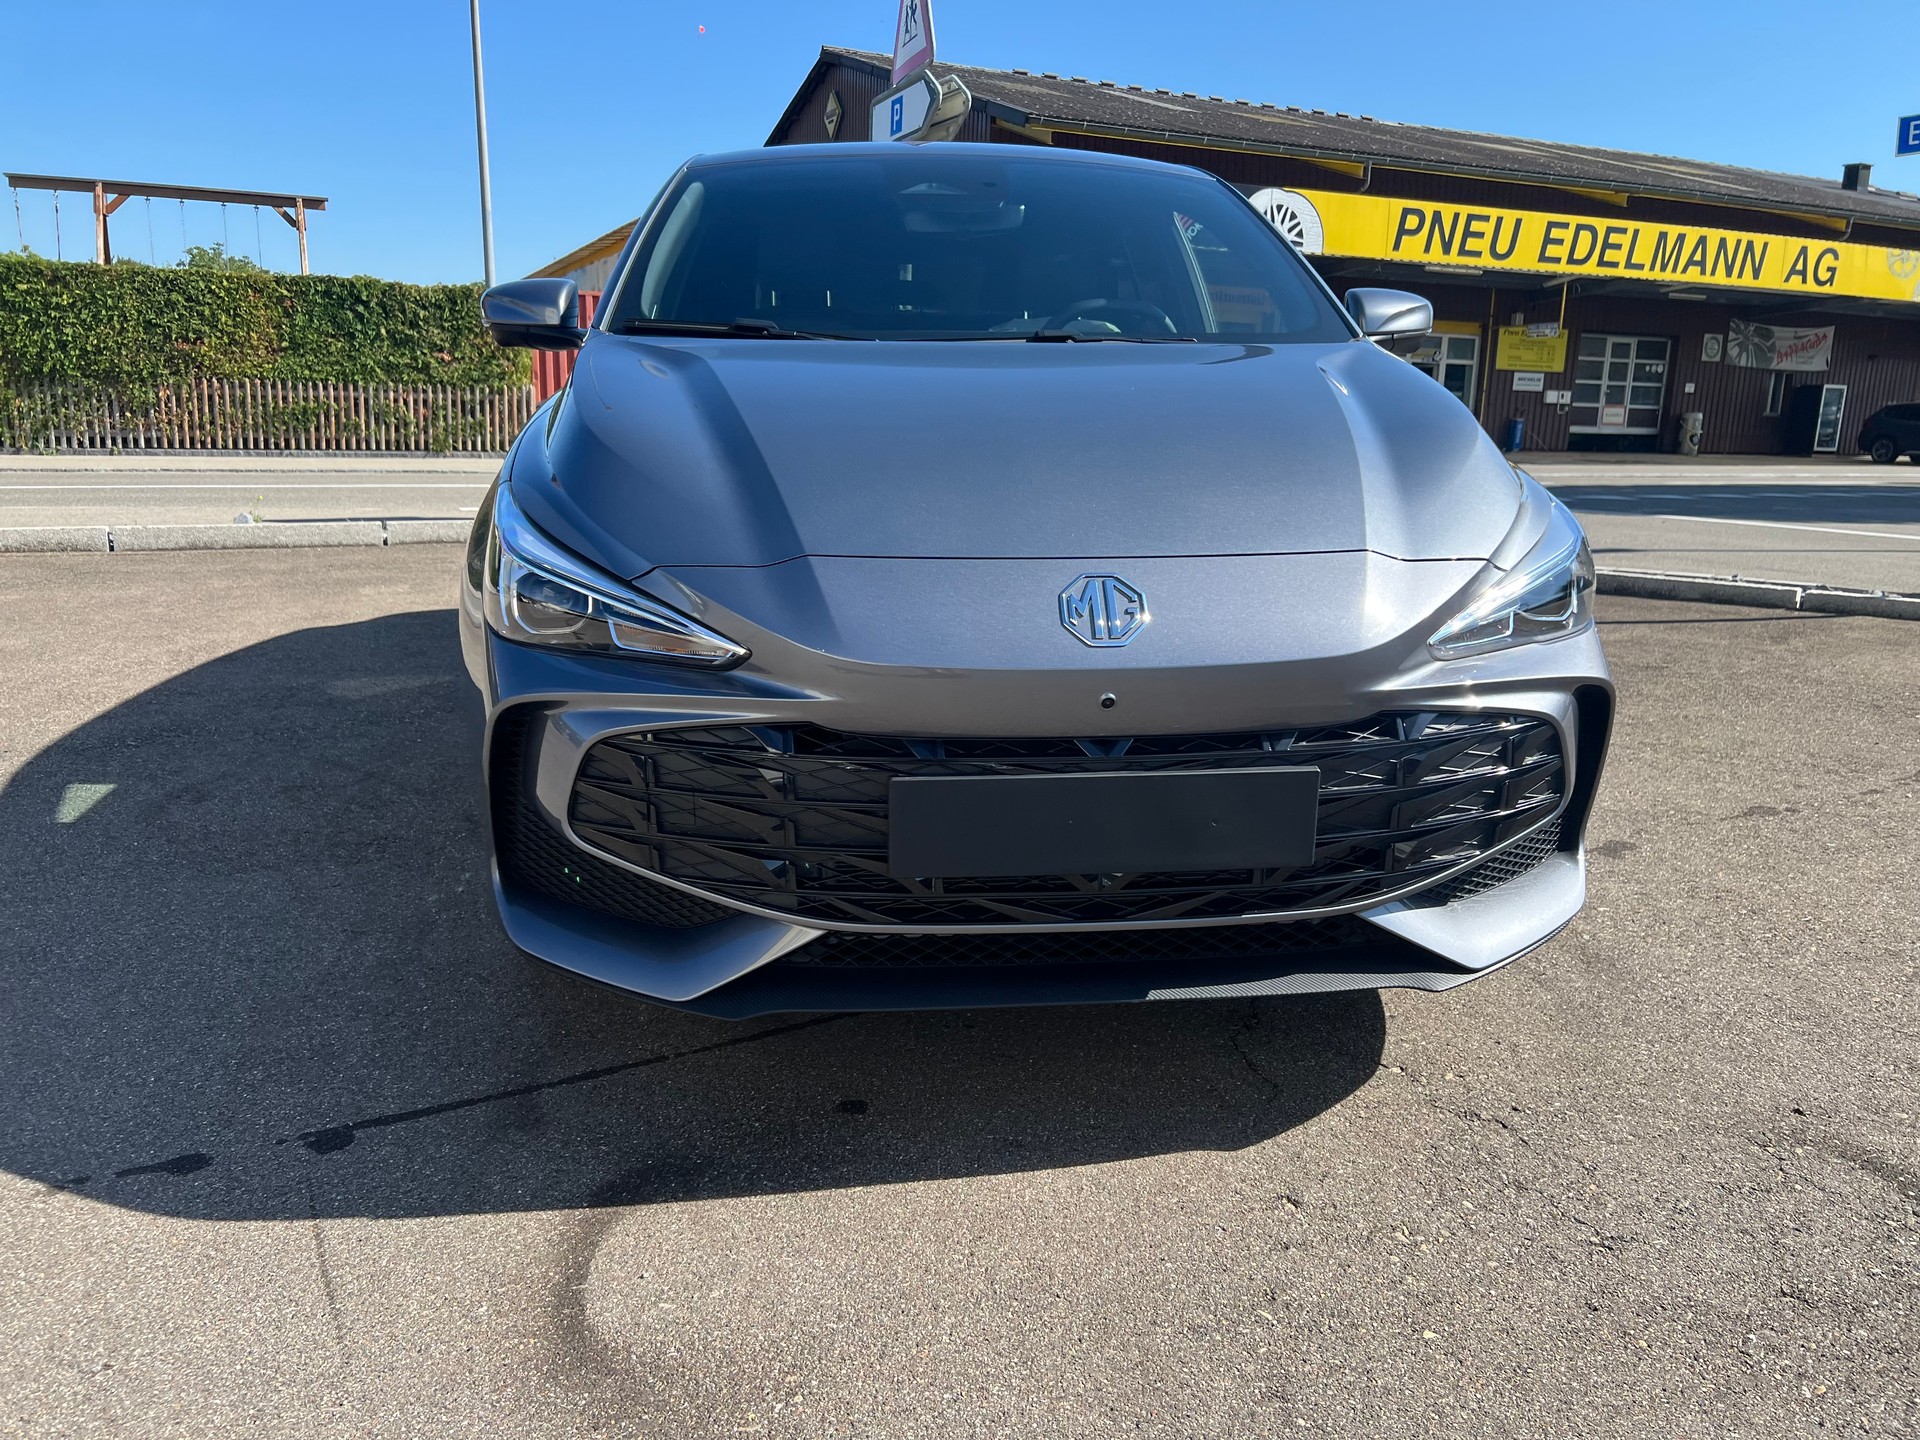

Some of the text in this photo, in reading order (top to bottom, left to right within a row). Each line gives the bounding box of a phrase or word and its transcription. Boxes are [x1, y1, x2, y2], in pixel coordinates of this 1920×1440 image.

[893, 103, 900, 130] P
[1392, 207, 1841, 287] PNEU EDELMANN AG
[1066, 578, 1142, 640] MG
